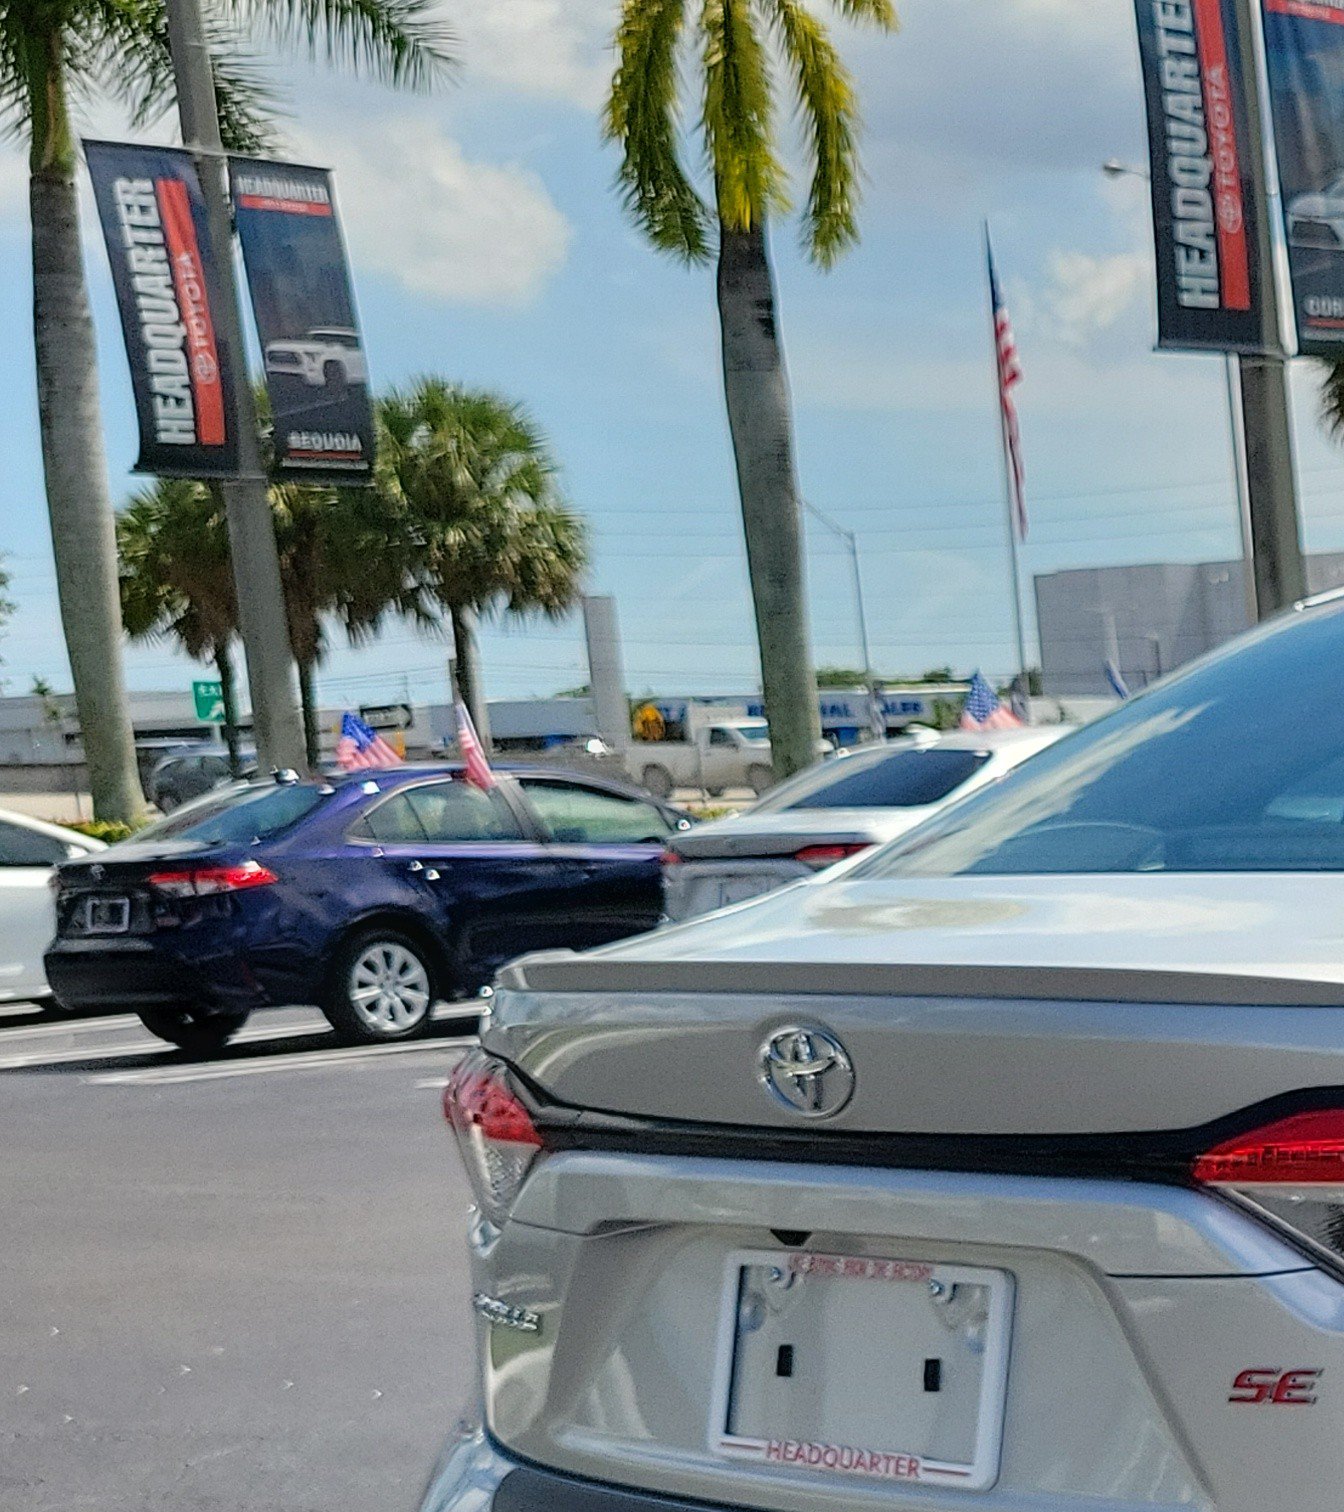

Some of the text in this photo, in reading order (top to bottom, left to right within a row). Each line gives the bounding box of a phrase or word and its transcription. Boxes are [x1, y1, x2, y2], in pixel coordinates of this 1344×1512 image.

[1153, 0, 1220, 309] HEADQUARTE
[1208, 65, 1237, 187] TOYOTA
[114, 177, 196, 444] HEADQUARTER
[175, 252, 210, 348] TOYOTA
[287, 430, 362, 452] SEQUOIA
[1228, 1367, 1324, 1404] SE
[765, 1439, 920, 1478] HEADQUARTER
